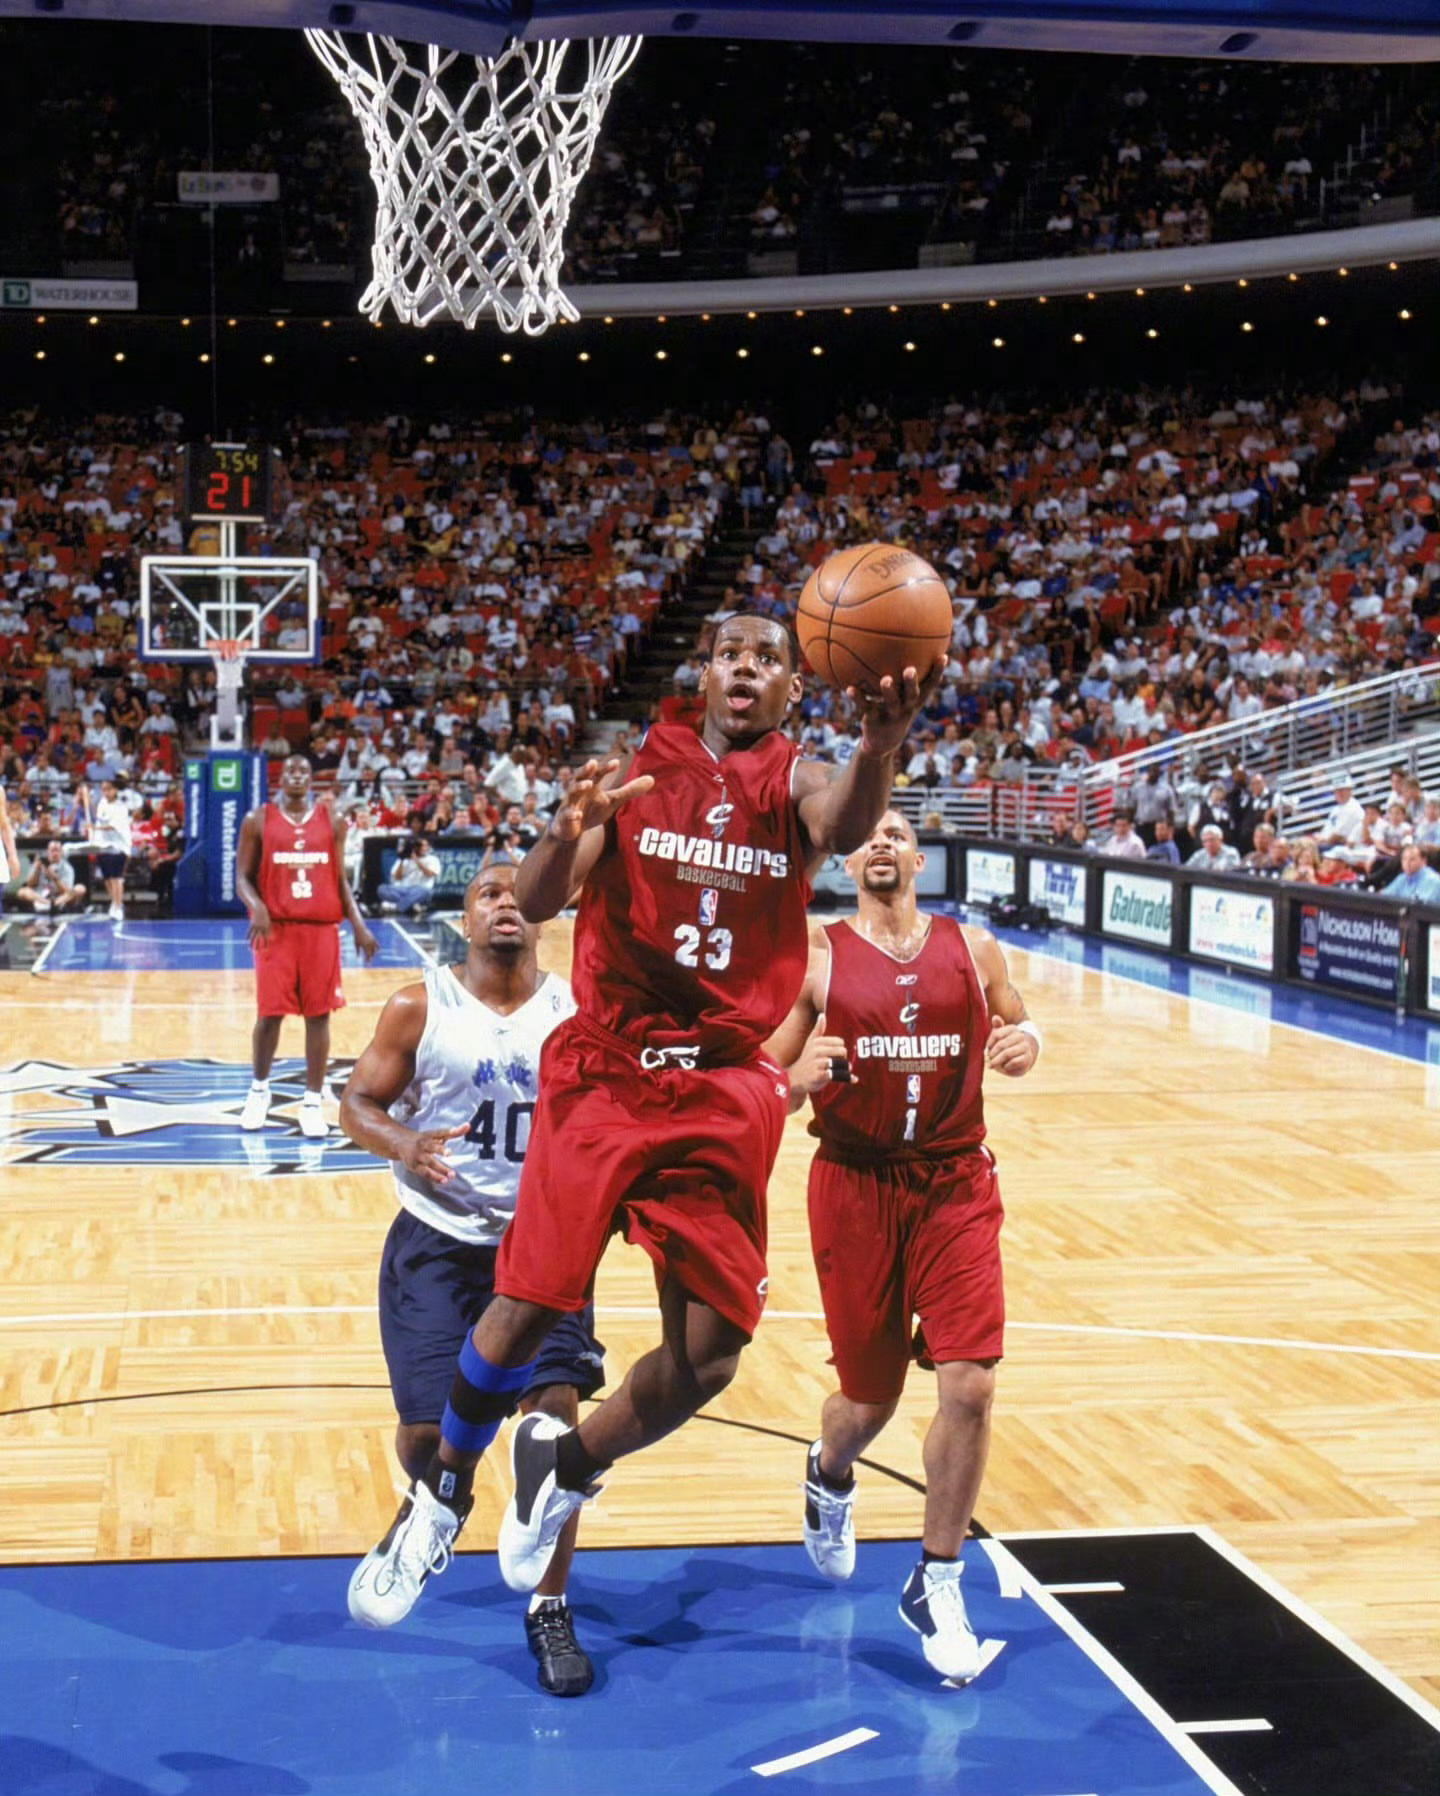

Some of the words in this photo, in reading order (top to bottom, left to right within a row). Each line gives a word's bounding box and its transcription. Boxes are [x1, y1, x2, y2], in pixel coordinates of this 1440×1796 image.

[207, 472, 250, 509] 21
[217, 761, 237, 788] TD
[221, 800, 237, 902] Waterhouse
[1110, 884, 1172, 931] Gatorade
[673, 923, 733, 971] 23
[465, 1099, 537, 1163] 40
[903, 1108, 918, 1142] 1
